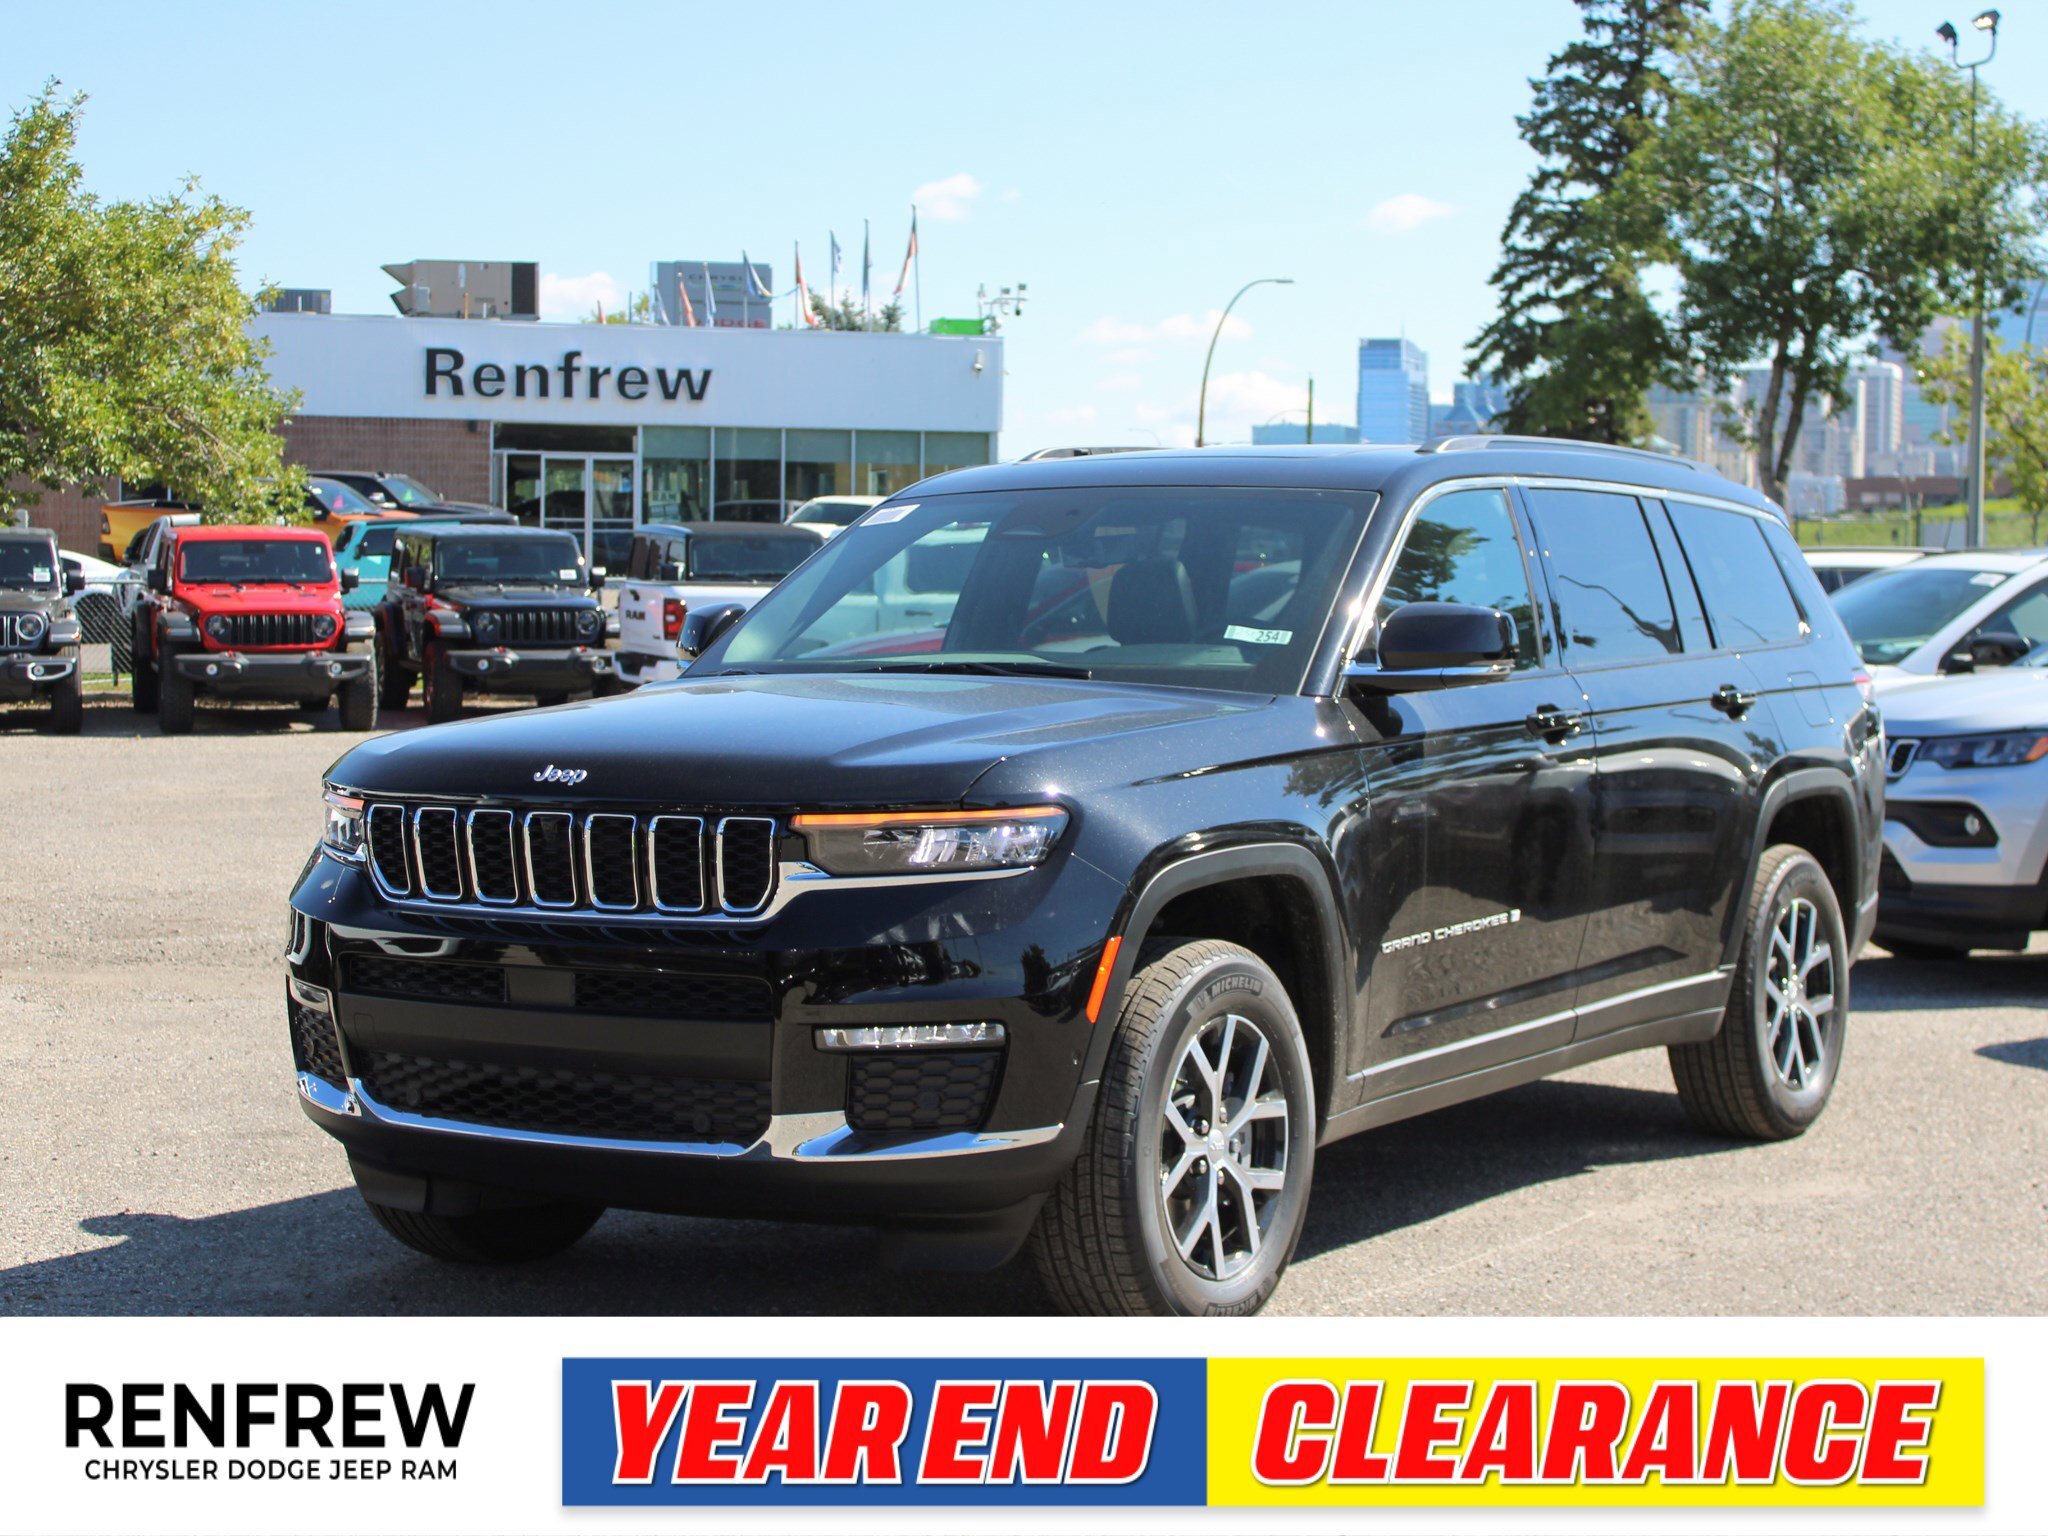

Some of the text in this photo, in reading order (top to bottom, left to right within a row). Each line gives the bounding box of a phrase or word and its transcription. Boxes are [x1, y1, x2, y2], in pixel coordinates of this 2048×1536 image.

[425, 347, 712, 401] Renfrew
[533, 764, 588, 786] Jeep
[1381, 931, 1432, 955] GRAND
[1433, 912, 1509, 941] CHEROKEE
[1210, 975, 1263, 999] MICHELIN
